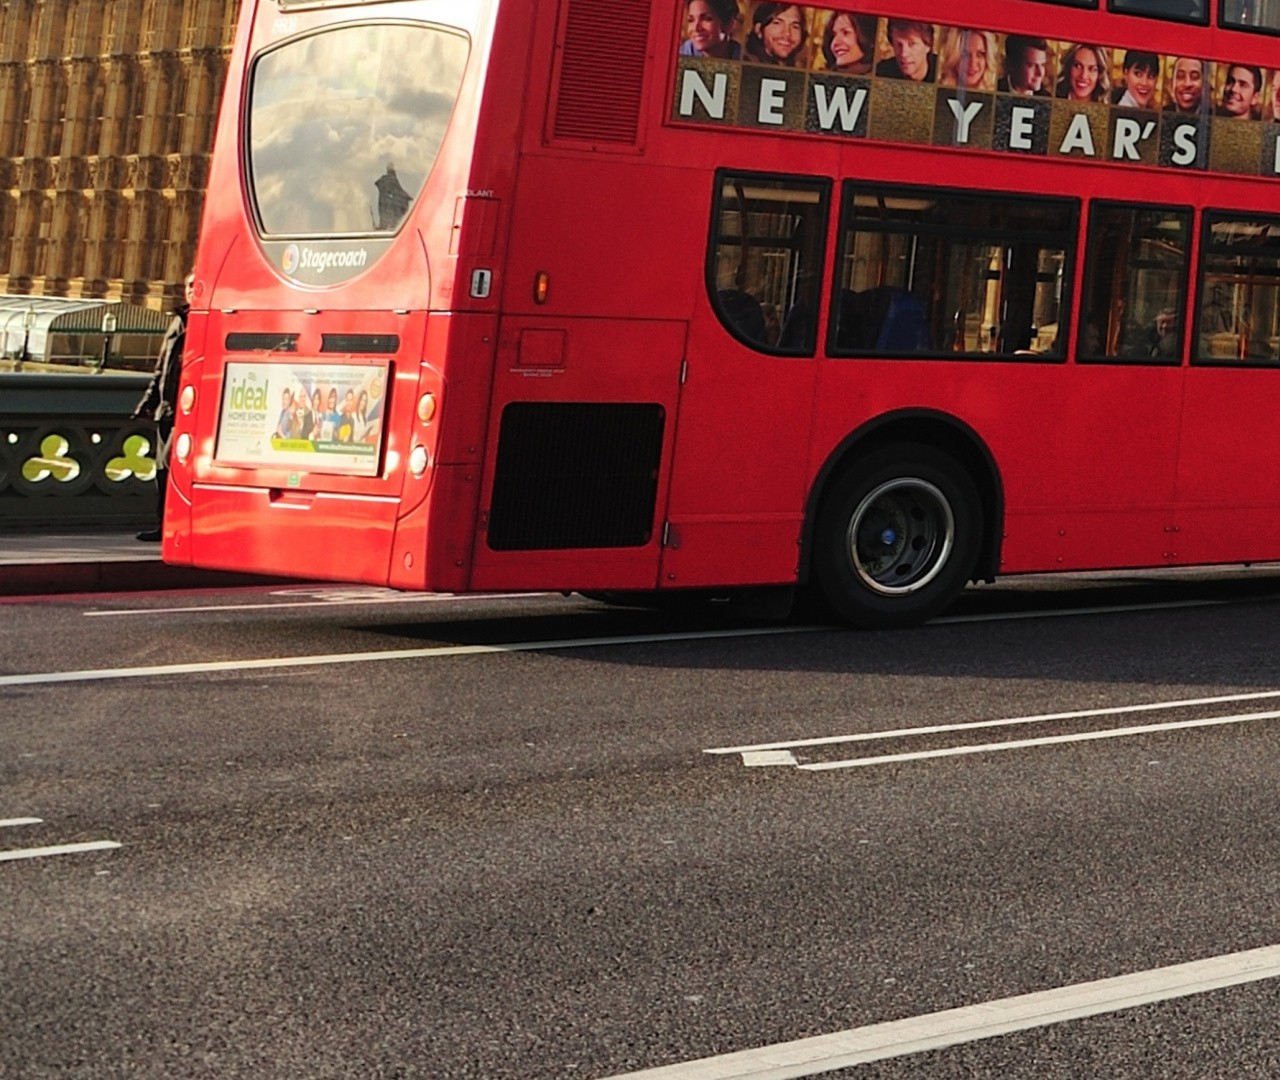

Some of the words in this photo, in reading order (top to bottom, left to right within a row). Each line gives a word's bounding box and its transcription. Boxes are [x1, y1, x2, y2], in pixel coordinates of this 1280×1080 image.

[679, 69, 867, 132] NEW
[948, 98, 1197, 166] YEAR'S
[300, 247, 367, 273] Stagecoach
[230, 377, 269, 410] ideal
